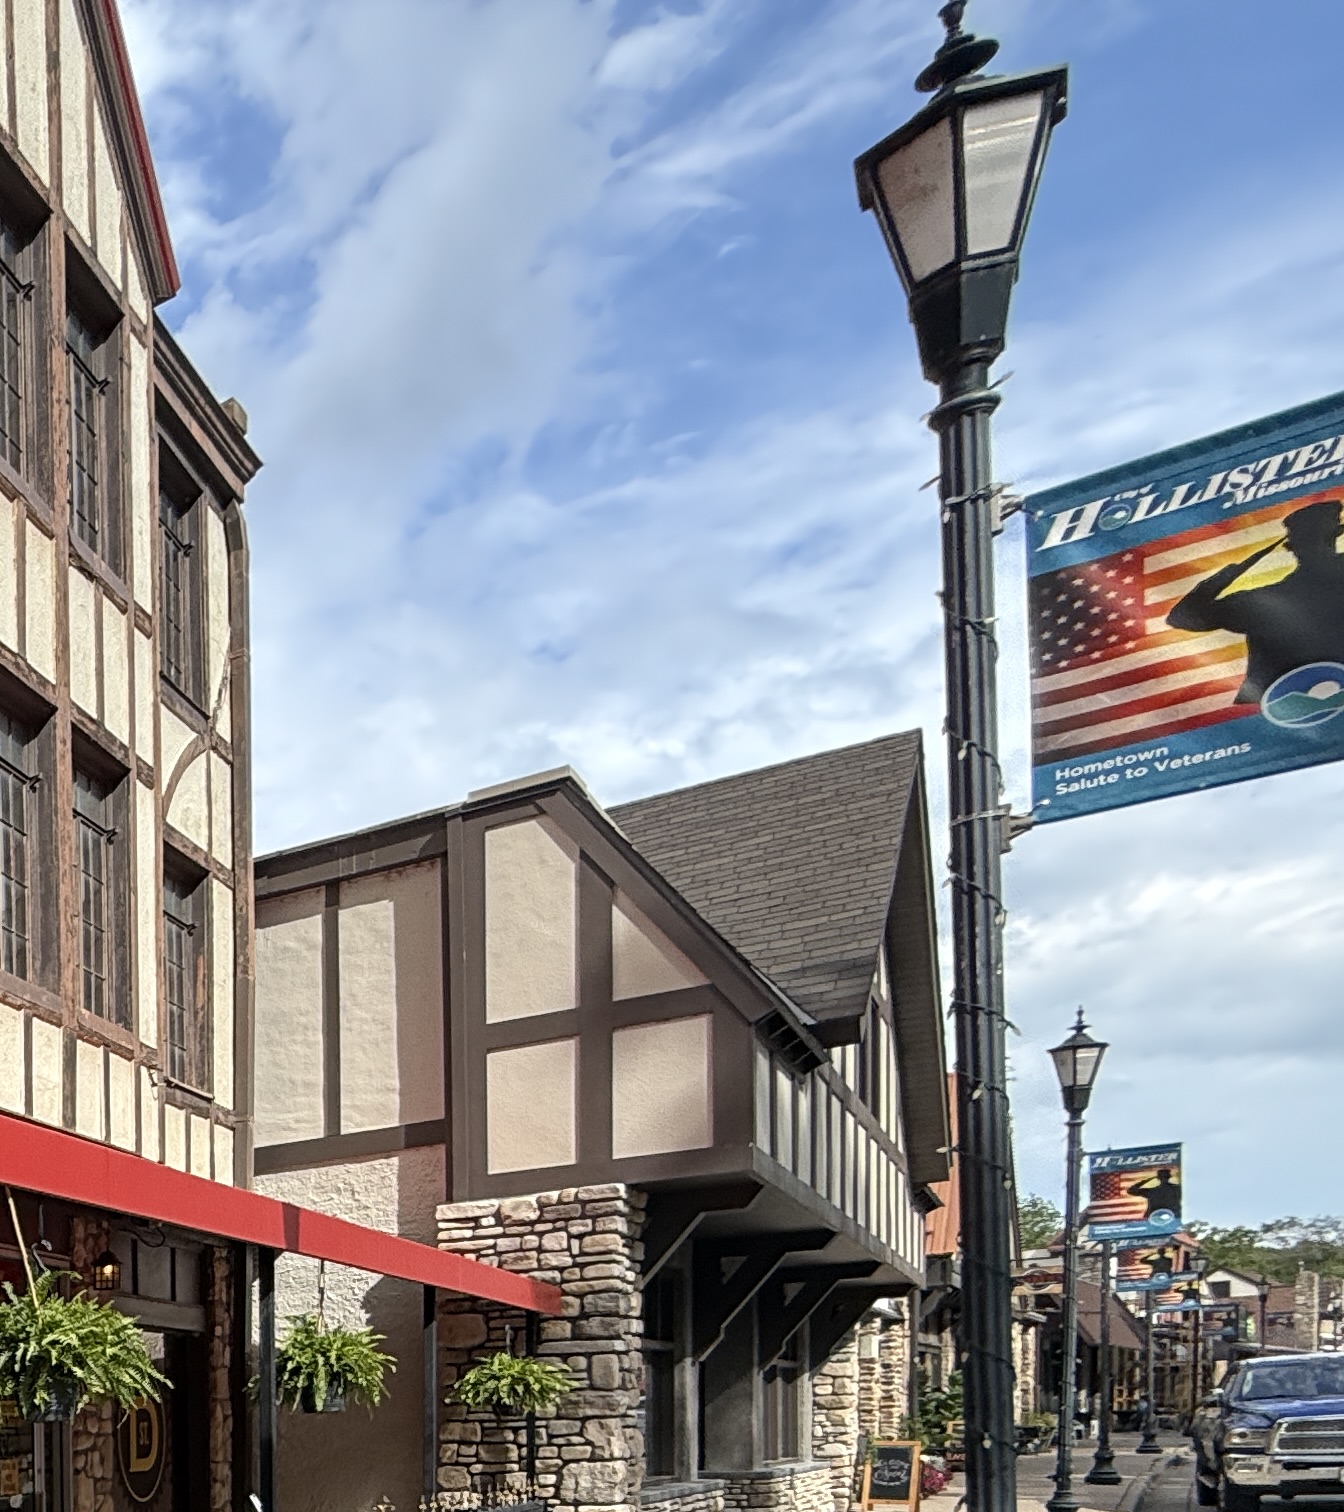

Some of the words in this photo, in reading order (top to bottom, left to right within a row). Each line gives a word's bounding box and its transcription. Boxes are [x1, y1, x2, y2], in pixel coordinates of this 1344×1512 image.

[1055, 746, 1169, 780] Hometown
[1055, 773, 1119, 795] Salute
[1125, 766, 1148, 779] to
[1154, 742, 1252, 771] Veterans
